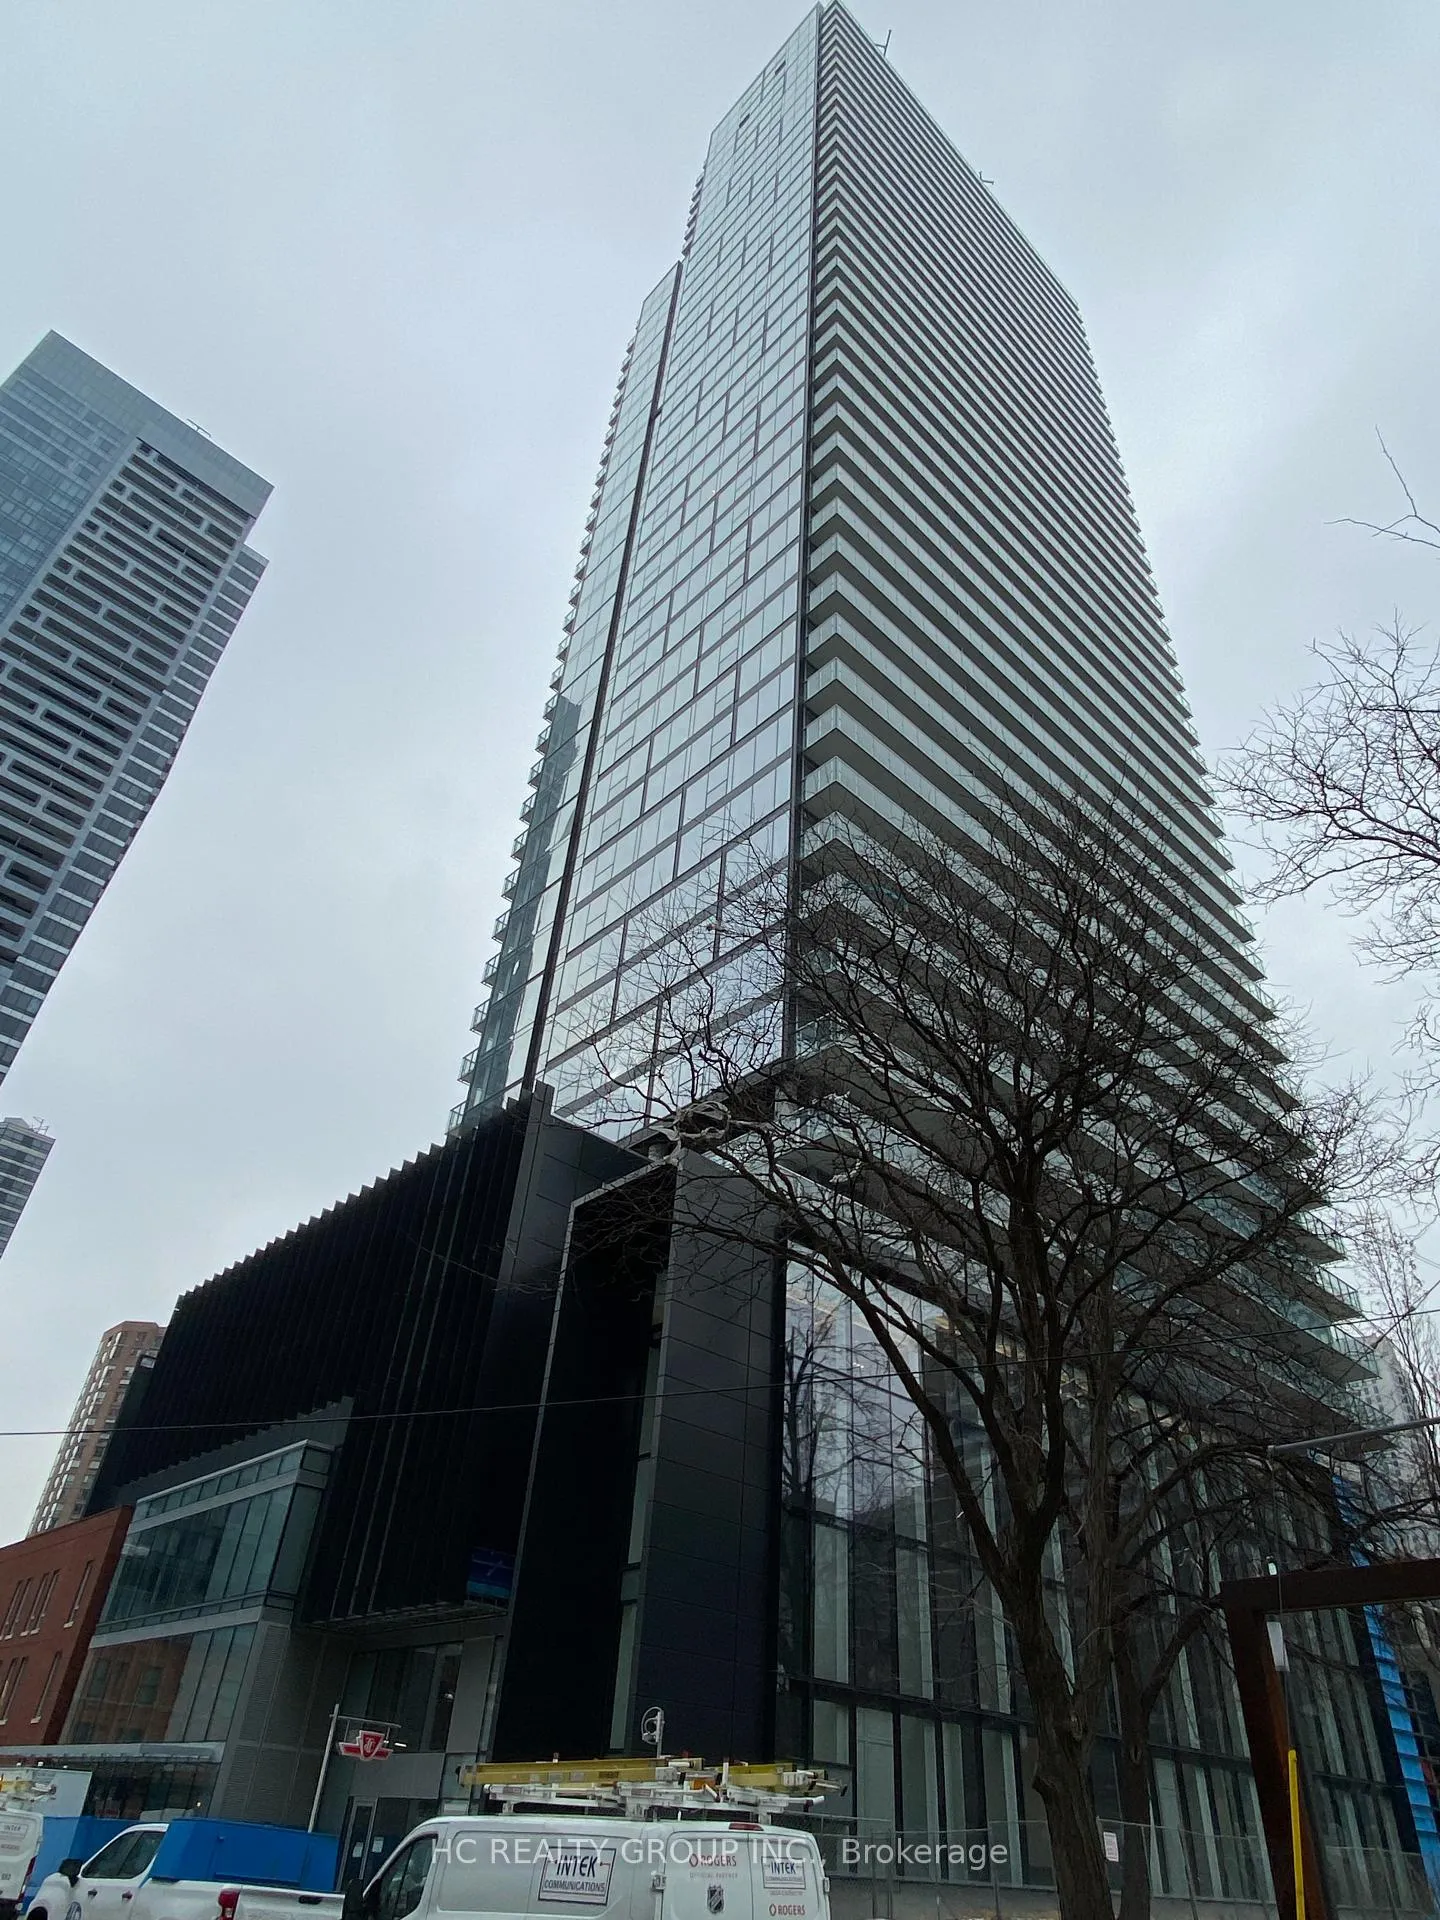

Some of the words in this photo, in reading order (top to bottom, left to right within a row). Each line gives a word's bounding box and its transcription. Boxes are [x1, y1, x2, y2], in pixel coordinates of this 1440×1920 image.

[556, 1854, 598, 1878] INTEK
[701, 1855, 737, 1867] ROGERS
[771, 1861, 797, 1875] INTEK
[544, 1879, 606, 1892] COMMUNICATIONS
[778, 1904, 806, 1916] ROGERS
